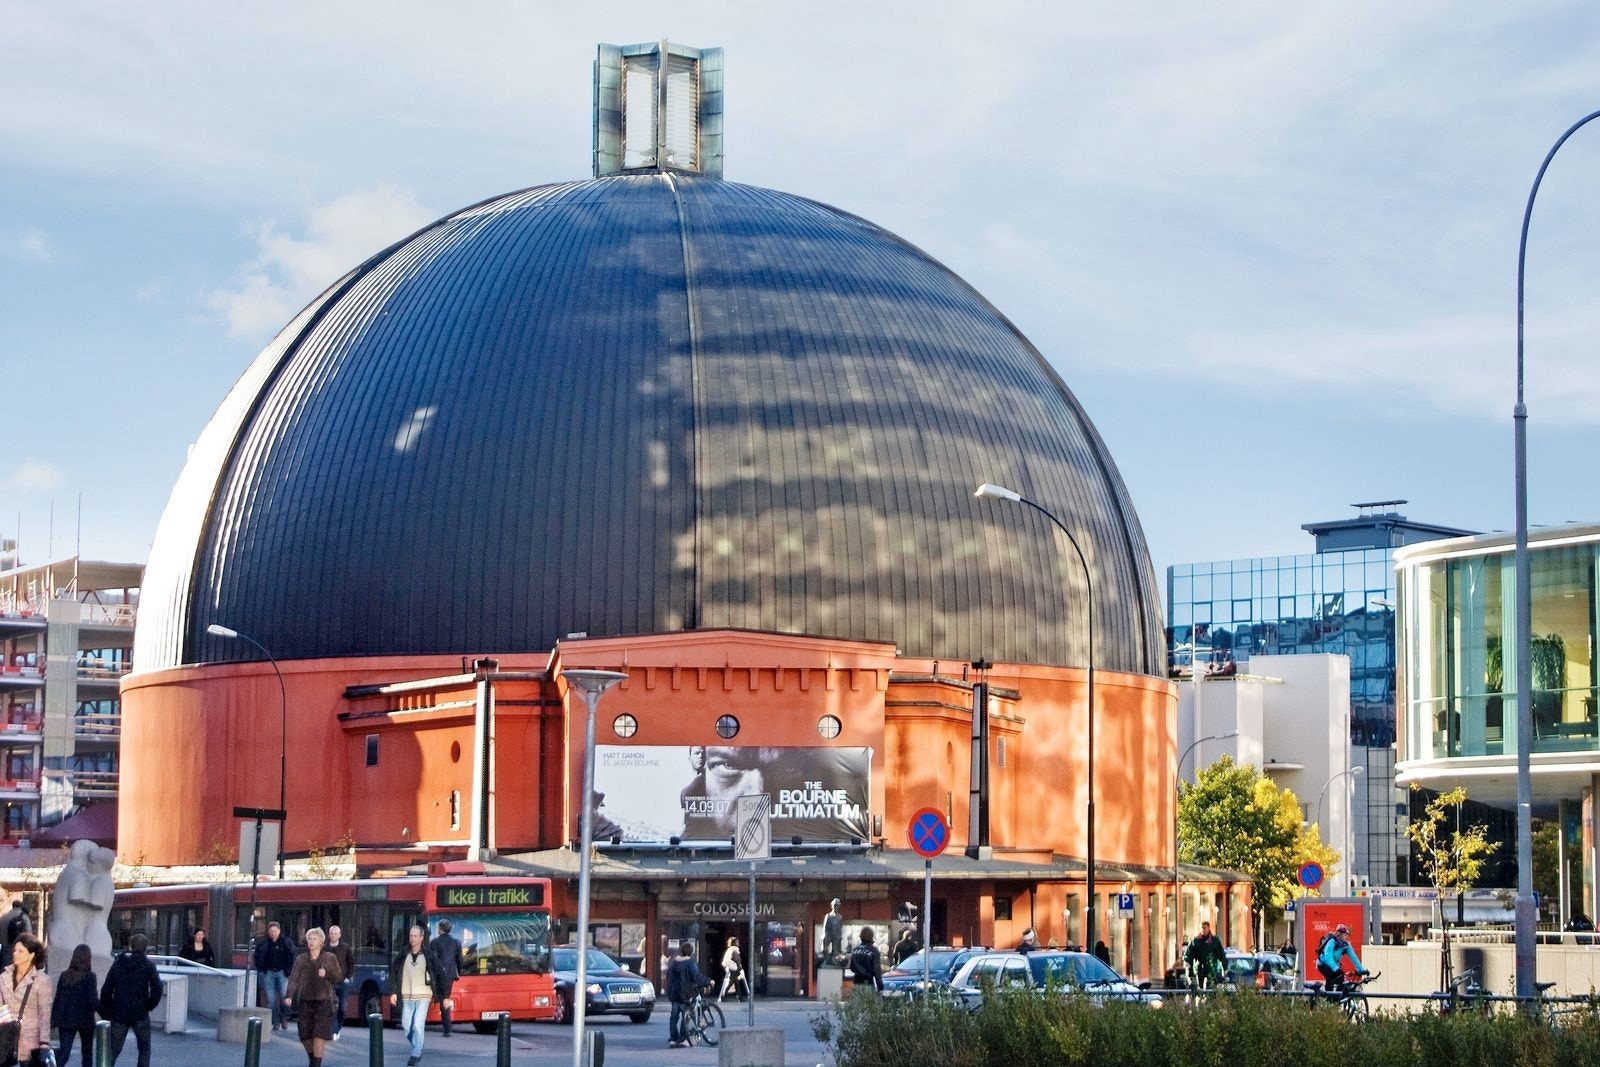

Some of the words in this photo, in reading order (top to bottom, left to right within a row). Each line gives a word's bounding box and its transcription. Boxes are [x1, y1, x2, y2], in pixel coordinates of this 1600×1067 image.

[804, 781, 822, 790] THE
[780, 789, 847, 804] BOURNE
[684, 800, 730, 813] 14.09.07
[769, 803, 860, 818] ULTIMATUM
[449, 889, 476, 905] Ikke
[488, 888, 530, 904] trafikk
[1122, 894, 1130, 908] P
[693, 902, 775, 915] COLOSSEUM
